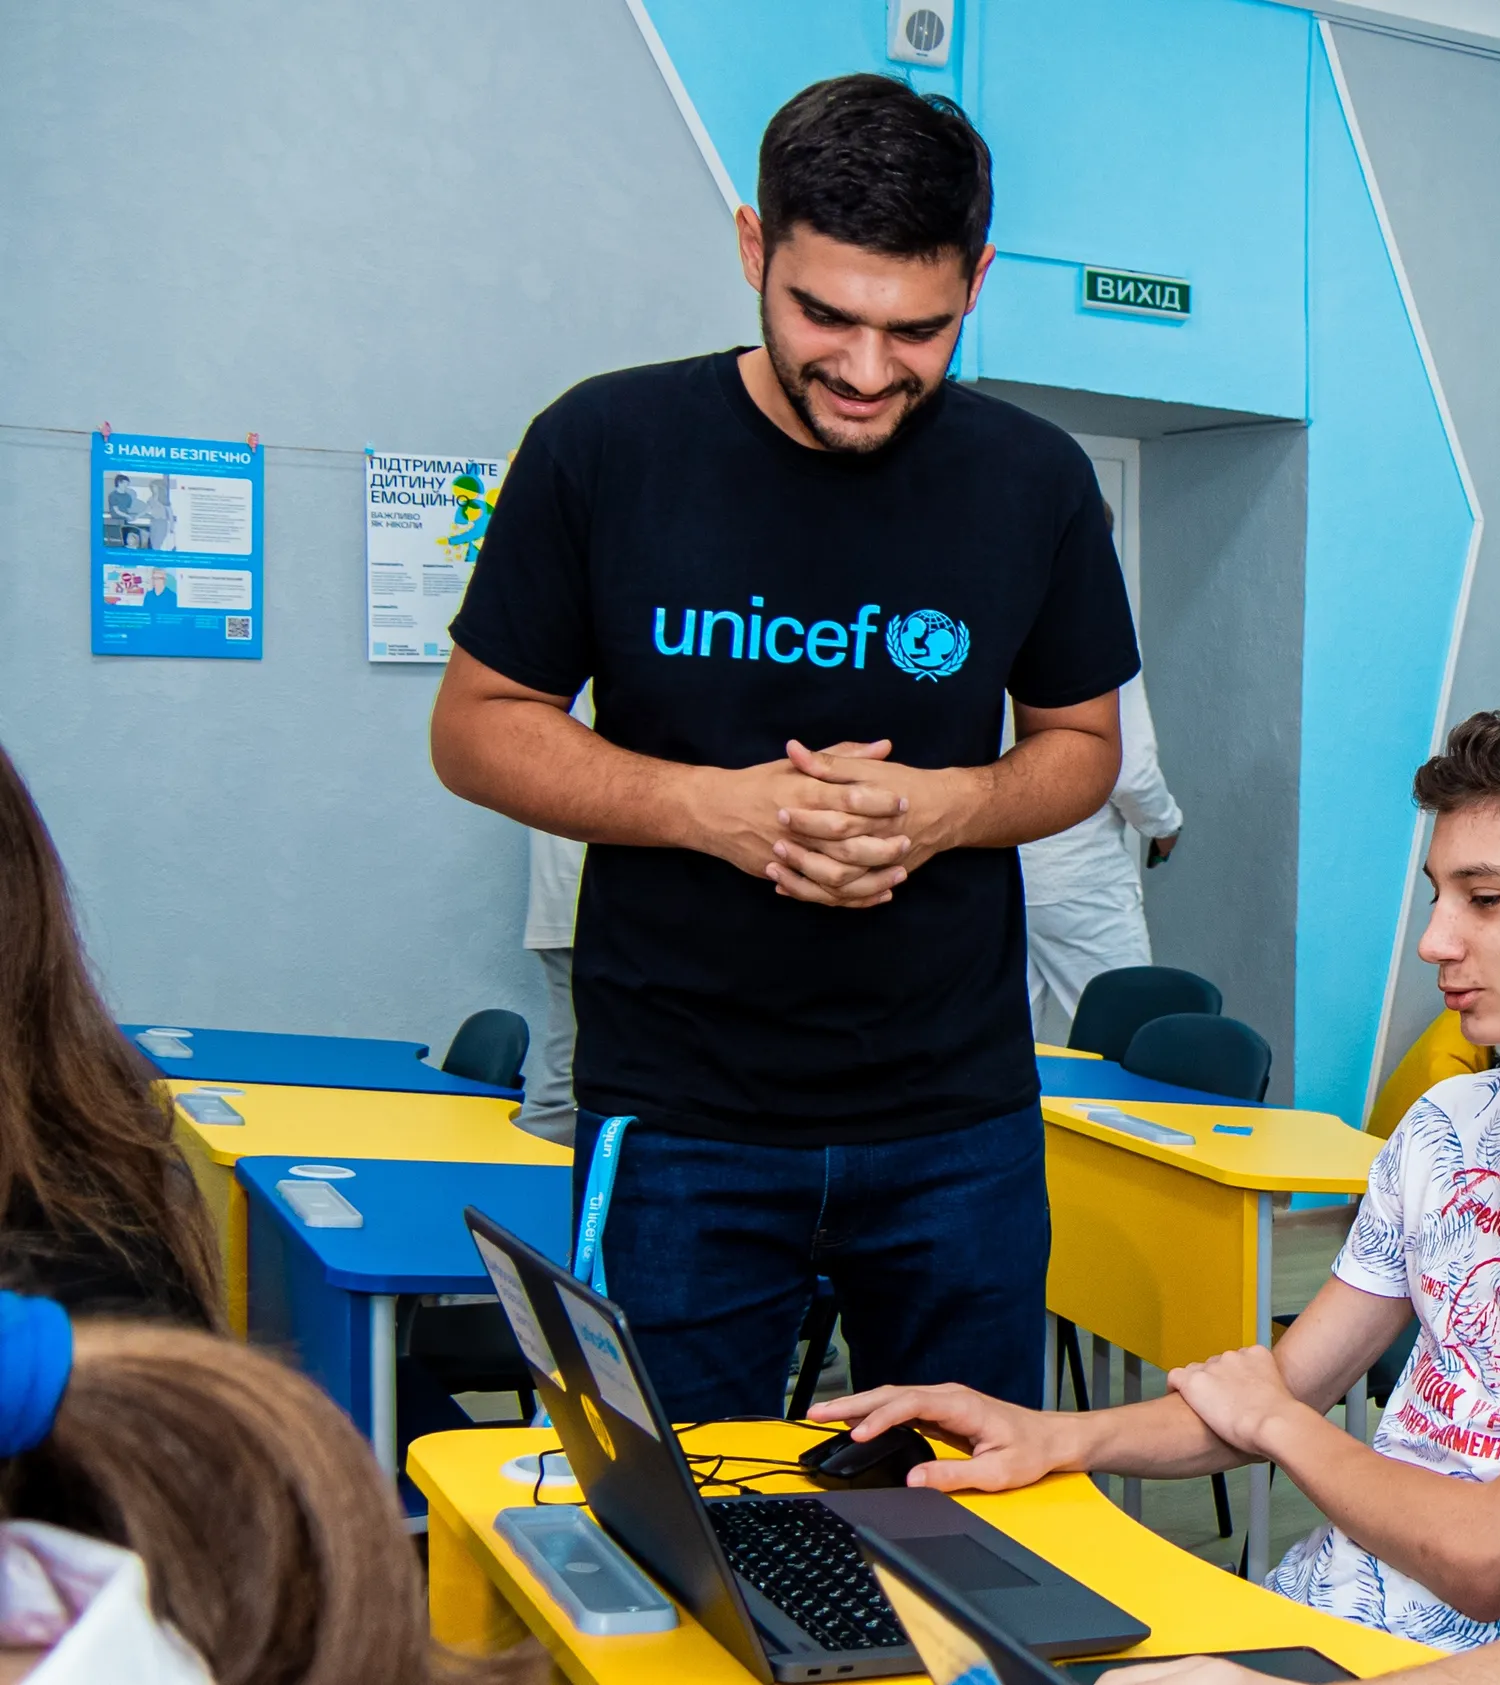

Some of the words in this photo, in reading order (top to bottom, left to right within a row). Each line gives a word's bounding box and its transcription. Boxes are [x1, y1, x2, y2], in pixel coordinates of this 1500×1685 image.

[1096, 276, 1181, 311] ВИХІД
[118, 444, 166, 458] НАМИ
[170, 447, 251, 465] БЕЗПЕЧНО
[370, 456, 498, 477] ПІДТРИМАЙТЕ
[370, 473, 446, 490] ДИТИНУ
[371, 490, 470, 508] ЕМОЦІЙНО
[371, 511, 421, 521] ВАЖЛИВО
[653, 595, 881, 670] unicef
[602, 1116, 624, 1158] unice
[1421, 1273, 1449, 1301] SINCE
